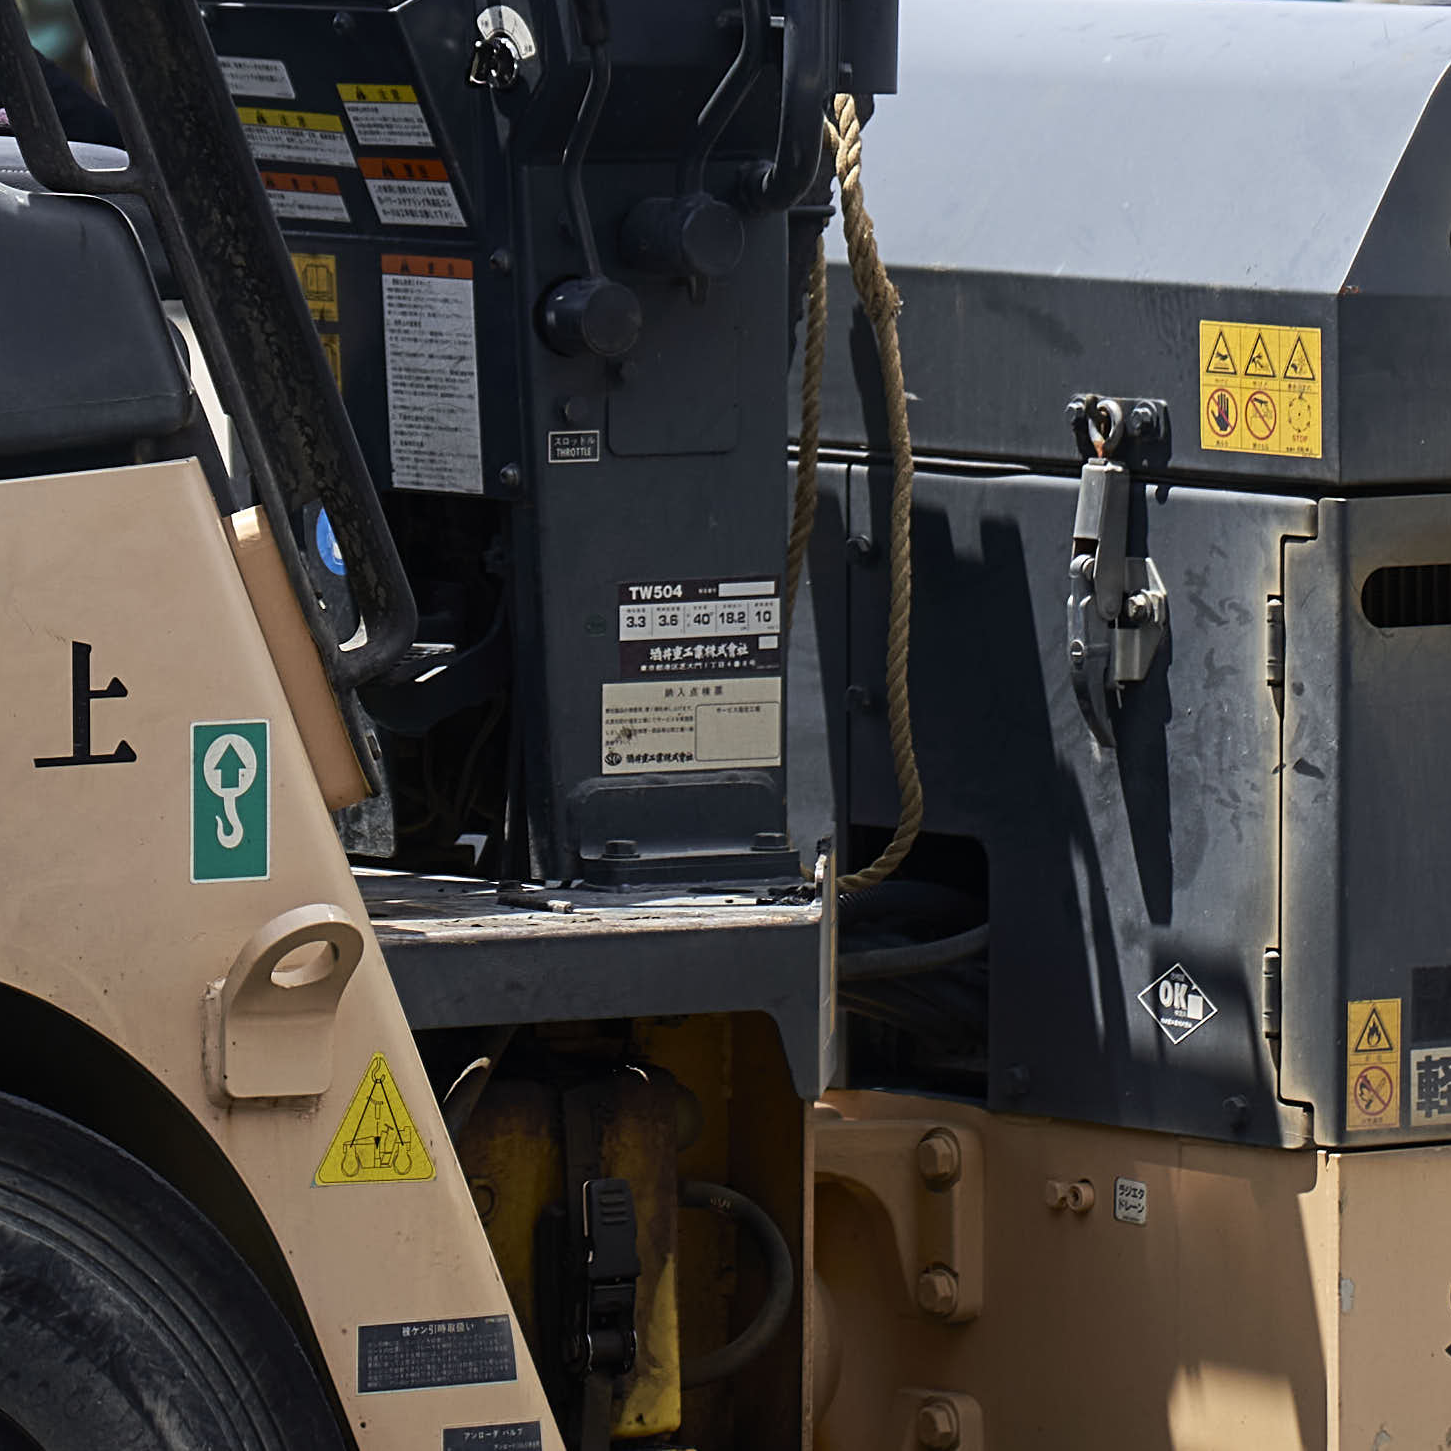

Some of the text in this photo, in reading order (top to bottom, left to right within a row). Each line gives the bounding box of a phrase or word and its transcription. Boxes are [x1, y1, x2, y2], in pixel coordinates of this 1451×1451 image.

[556, 446, 591, 458] THROTTLE
[628, 584, 684, 601] TW504
[625, 615, 647, 629] 3.3
[658, 614, 680, 627] 3.6
[718, 611, 747, 625] 18.2
[755, 610, 772, 623] 10
[1158, 979, 1189, 1011] OK
